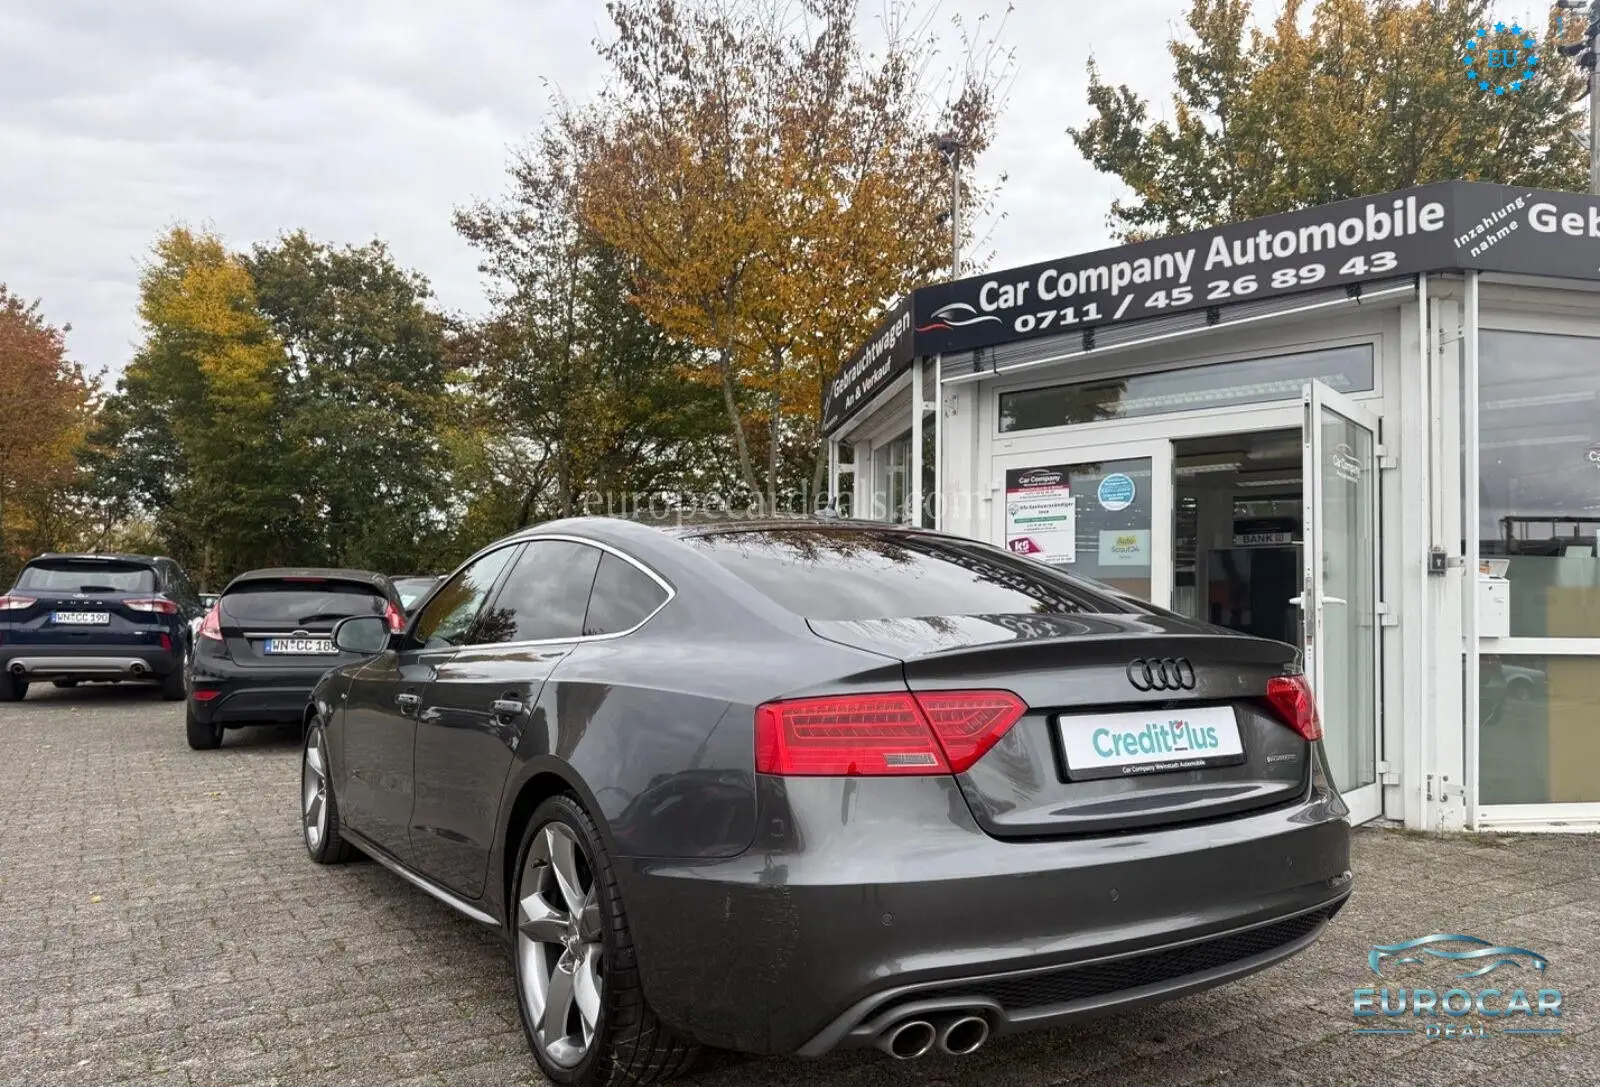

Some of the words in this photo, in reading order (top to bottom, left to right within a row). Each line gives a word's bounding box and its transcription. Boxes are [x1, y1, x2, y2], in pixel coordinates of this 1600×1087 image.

[978, 280, 1030, 312] Car
[1036, 248, 1196, 297] Company
[1203, 195, 1445, 271] Automobile
[1470, 219, 1519, 257] nahme
[1013, 302, 1103, 333] 0711
[1144, 285, 1194, 309] 45
[1206, 274, 1259, 301] 26
[1270, 263, 1327, 289] 89
[1338, 250, 1398, 276] 43
[833, 310, 910, 399] Gebrauchtwagen
[845, 394, 855, 410] An
[862, 355, 892, 393] Verkauf
[1018, 476, 1030, 484] Car
[1030, 474, 1061, 484] Company
[1243, 532, 1273, 543] BANK
[272, 640, 289, 651] WN
[296, 640, 312, 651] CC
[1092, 720, 1219, 758] CreditPlus
